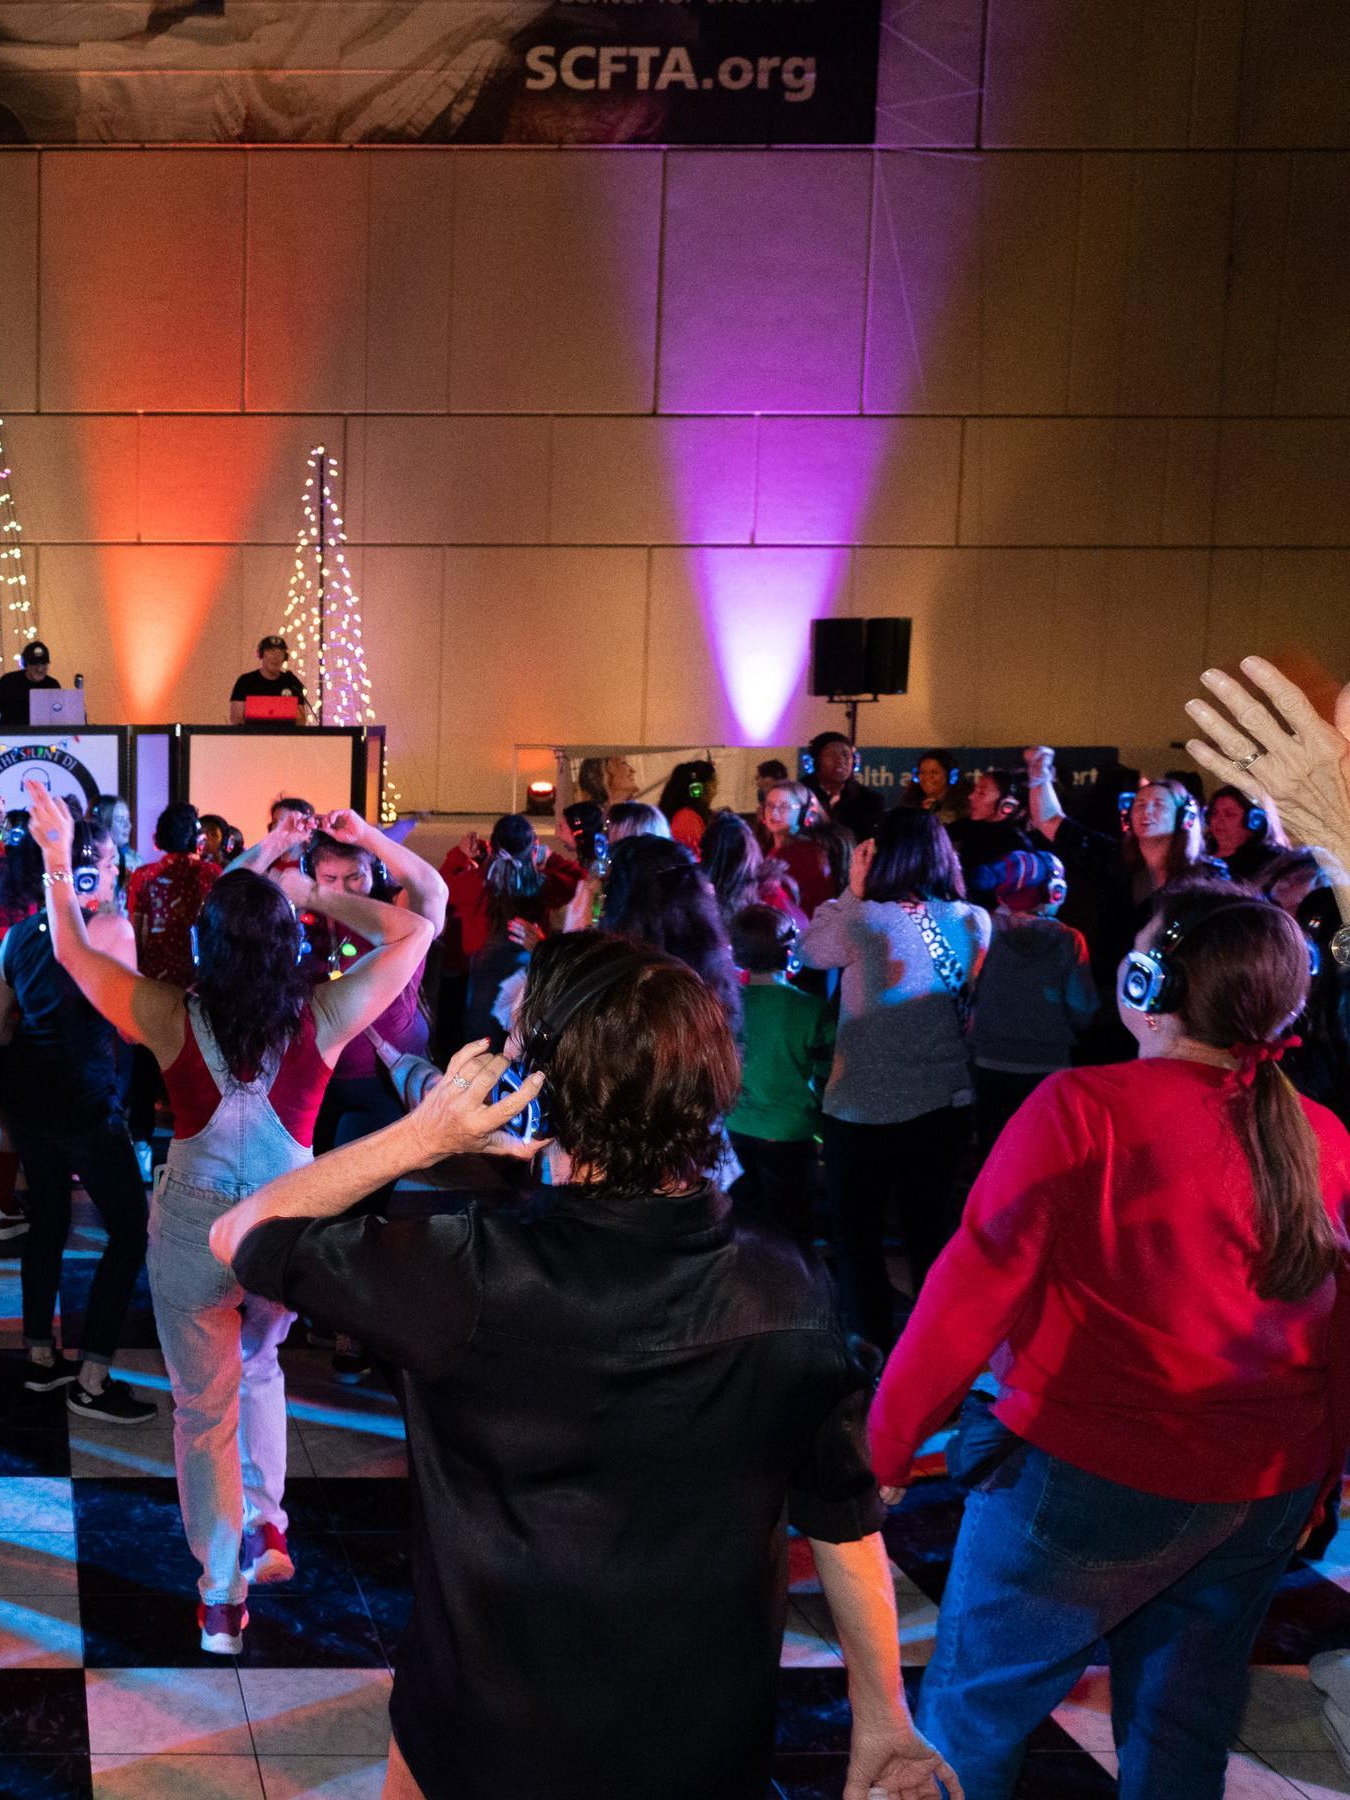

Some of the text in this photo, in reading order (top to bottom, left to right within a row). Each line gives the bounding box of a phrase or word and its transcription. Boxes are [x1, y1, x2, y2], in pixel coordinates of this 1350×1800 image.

[524, 45, 818, 101] SCFTA.org
[19, 747, 62, 762] SLNT
[853, 765, 895, 787] alth
